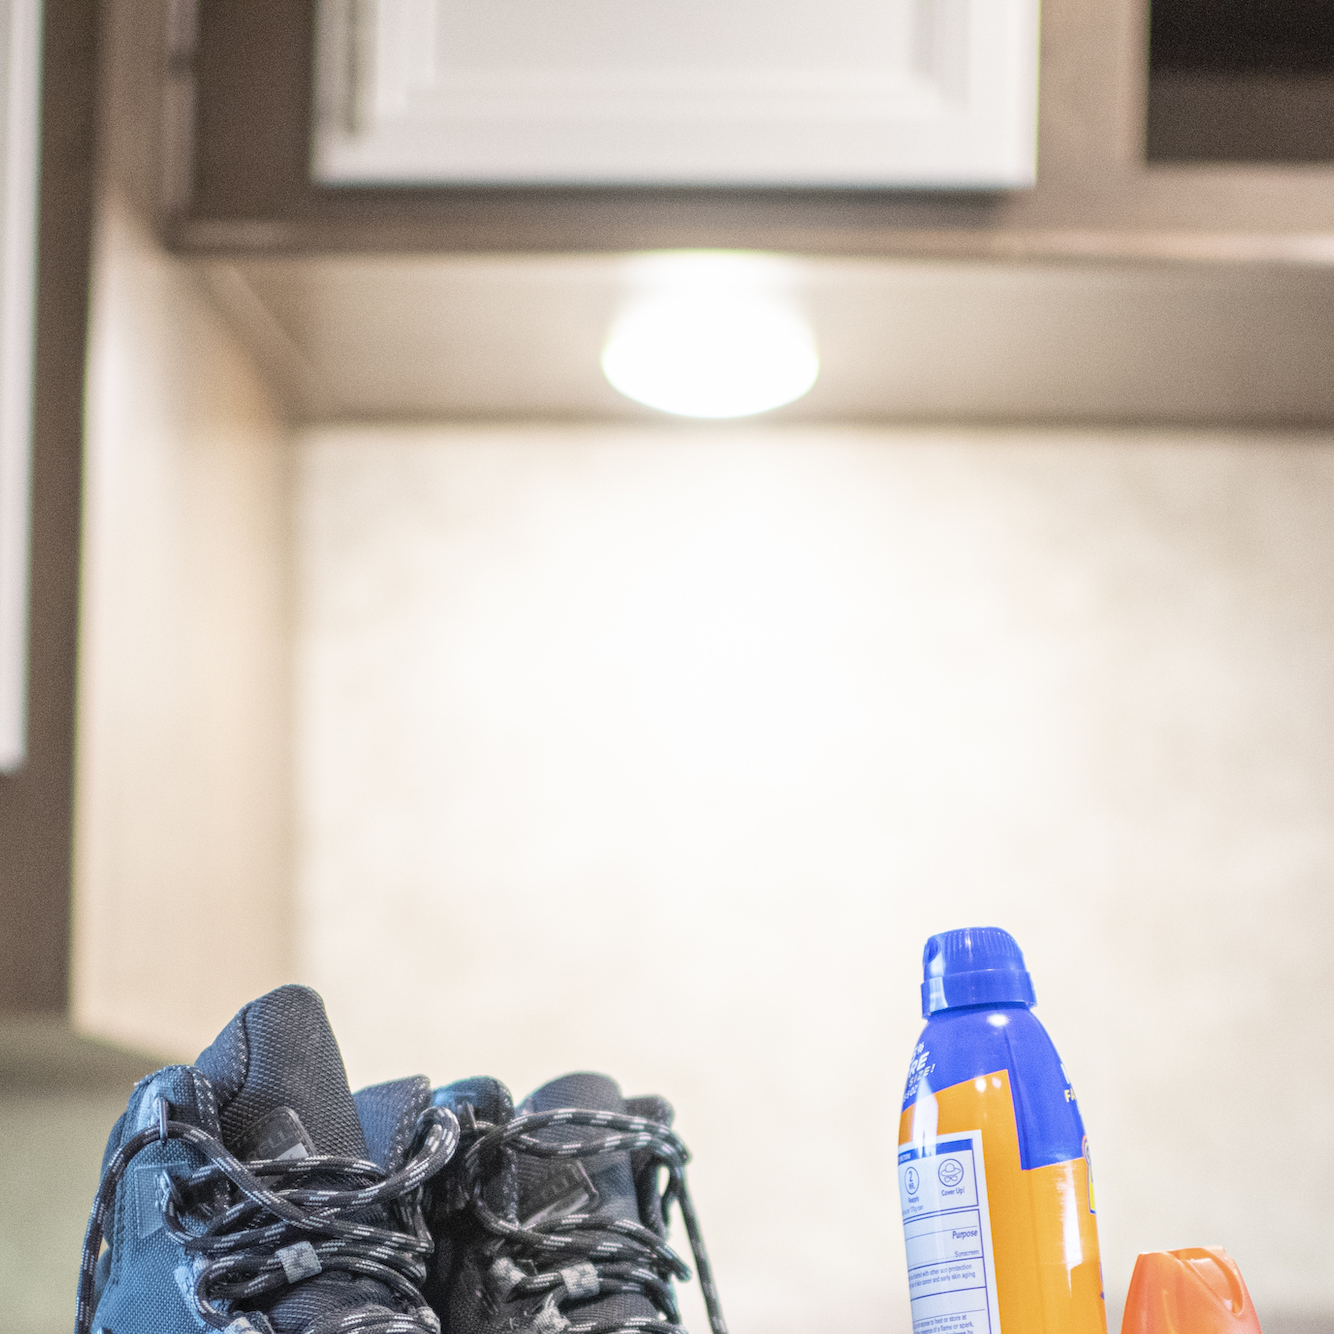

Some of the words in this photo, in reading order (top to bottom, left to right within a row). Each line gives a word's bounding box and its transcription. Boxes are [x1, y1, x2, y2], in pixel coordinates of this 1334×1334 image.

[909, 1064, 935, 1087] SIZE!
[909, 1170, 913, 1182] 2
[956, 1186, 965, 1195] Up!
[953, 1230, 978, 1240] Purpose
[949, 1264, 972, 1272] protection
